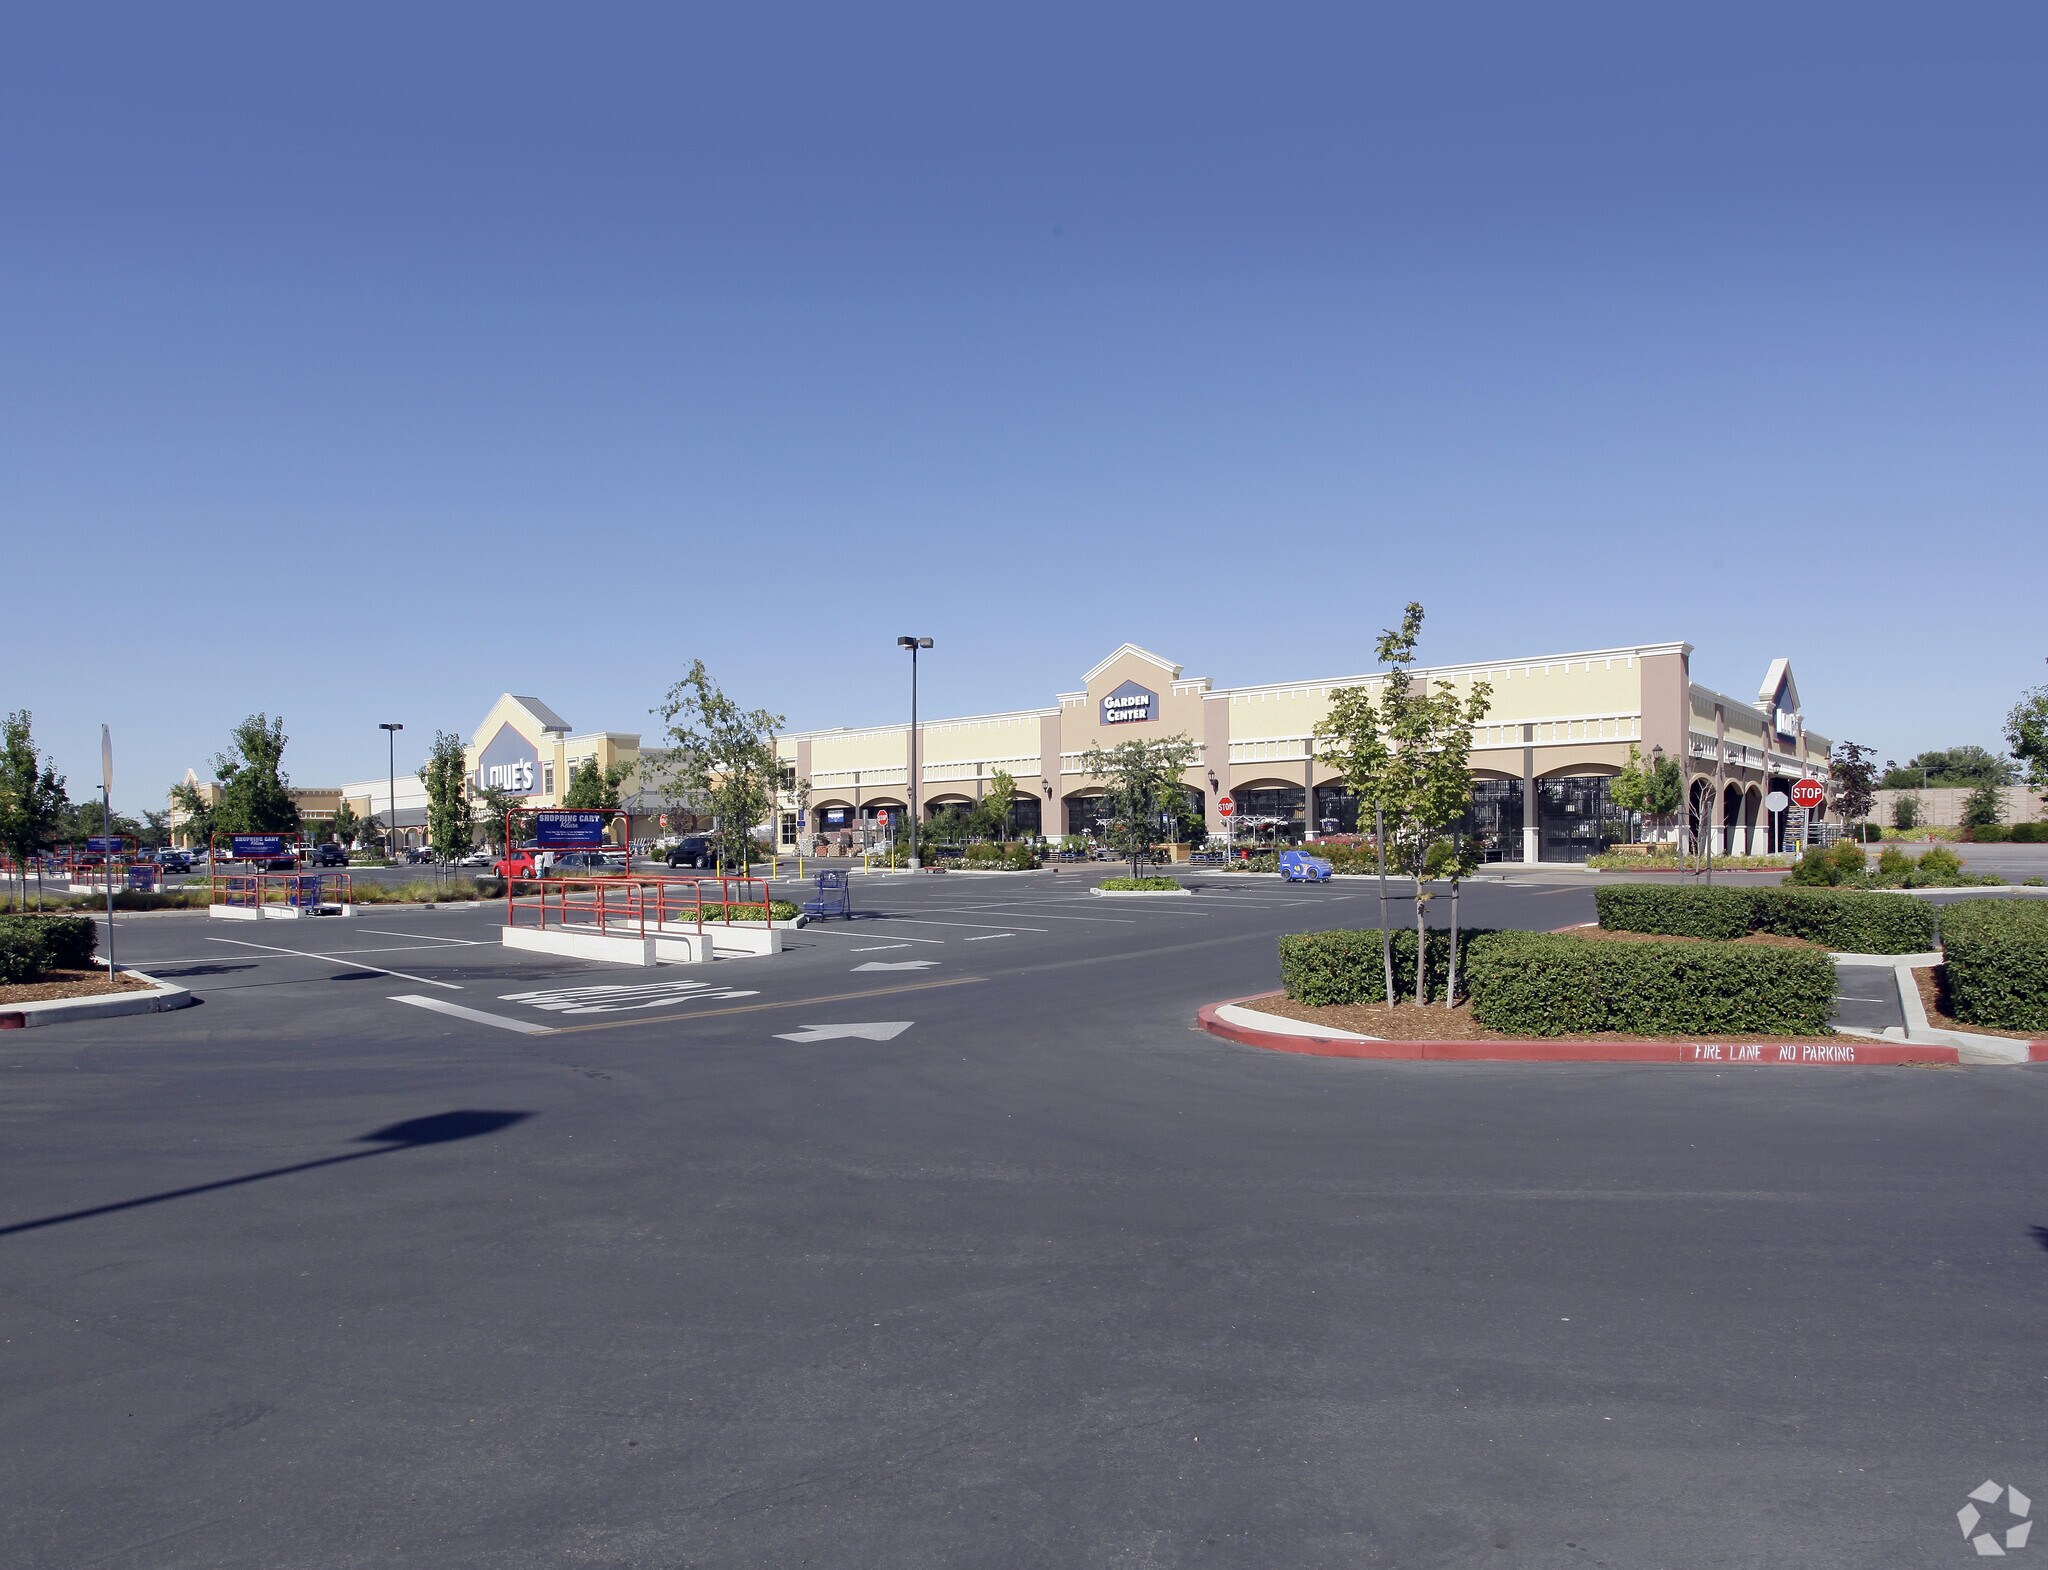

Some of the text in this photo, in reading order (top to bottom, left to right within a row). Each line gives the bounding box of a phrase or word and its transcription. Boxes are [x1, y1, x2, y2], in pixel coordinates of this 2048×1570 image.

[1104, 695, 1149, 709] GARDEN
[1106, 709, 1146, 722] CENTER
[480, 757, 534, 791] LOWE'S
[1793, 787, 1822, 798] STOP
[1218, 802, 1233, 811] STOP
[539, 814, 600, 822] SHOPPING CART
[1695, 1045, 1855, 1062] FIRE LANE NO PARKING
